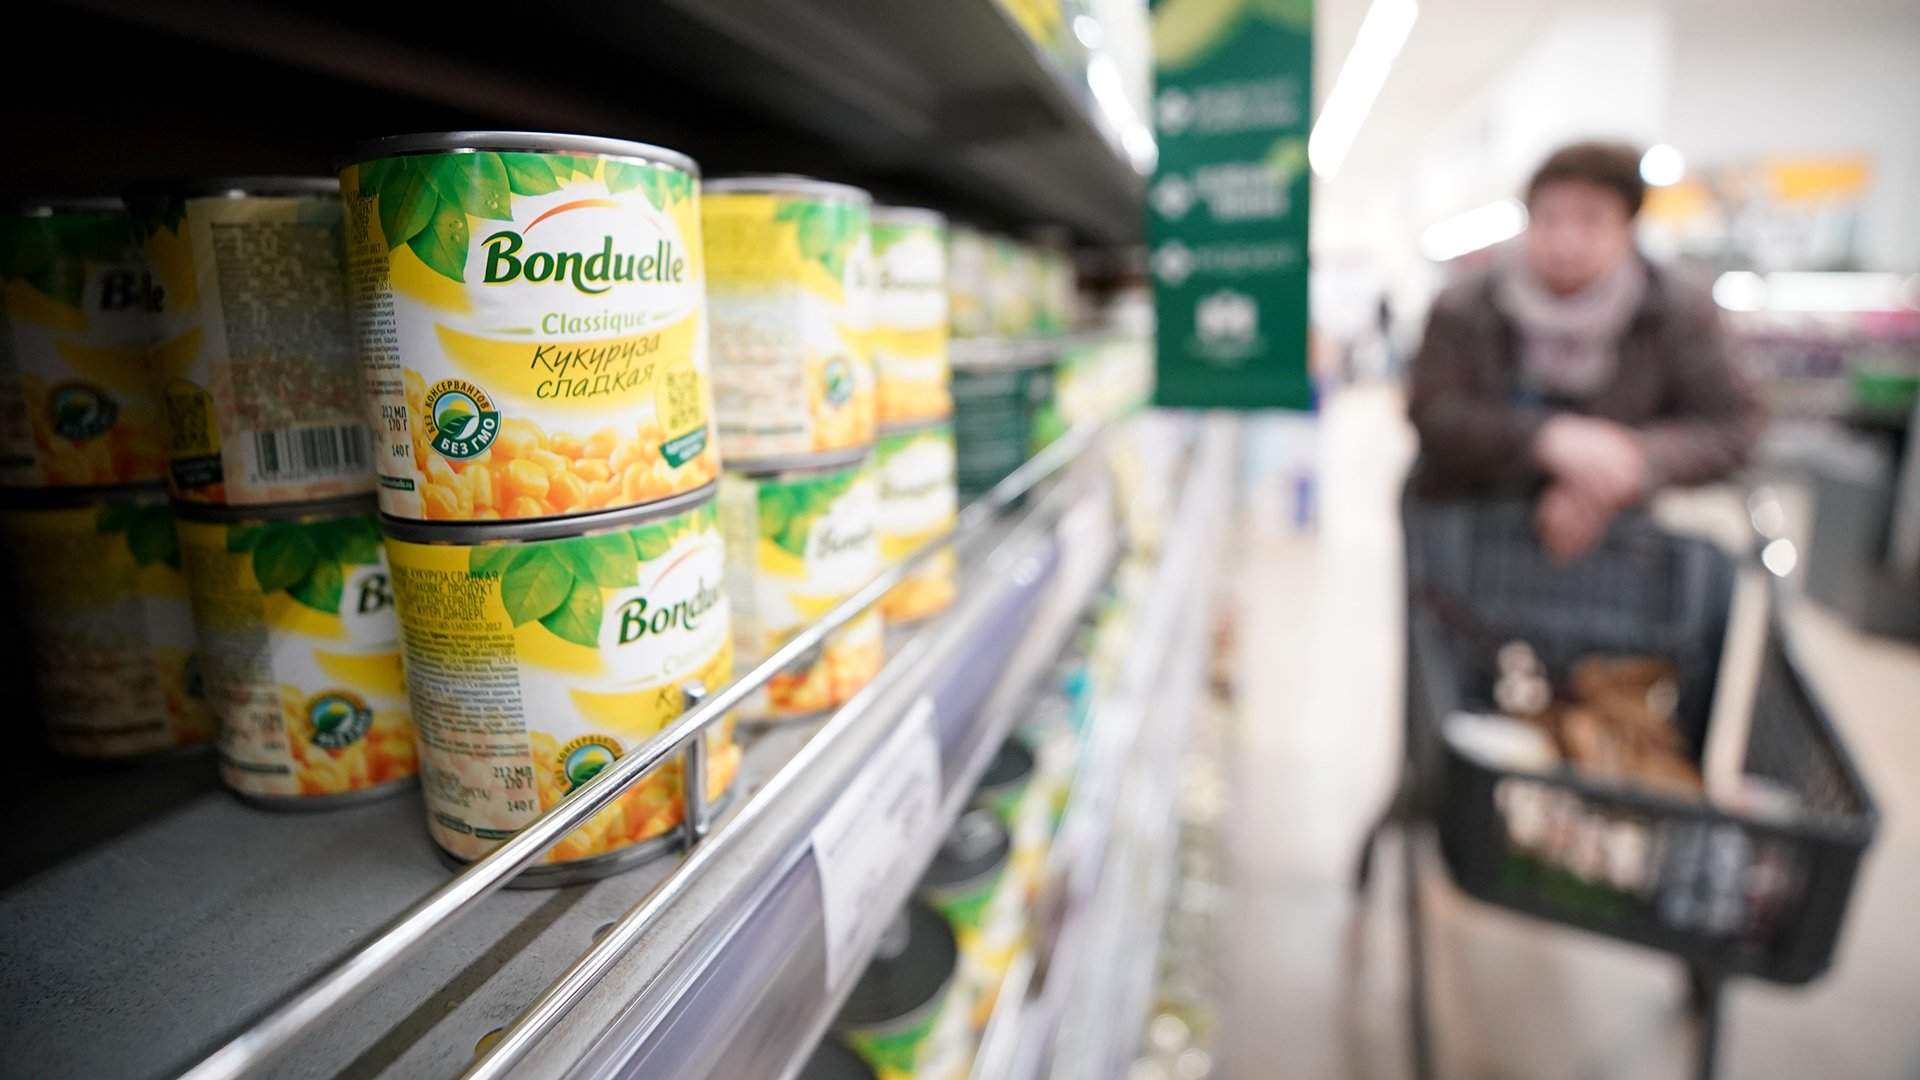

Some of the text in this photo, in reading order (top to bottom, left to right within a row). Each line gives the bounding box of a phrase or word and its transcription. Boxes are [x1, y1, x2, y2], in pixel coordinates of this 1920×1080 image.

[481, 230, 684, 294] Bonduelle
[541, 309, 647, 335] Classique
[531, 333, 661, 377] Кукуруза
[425, 380, 490, 409] КОНСЕРВАНТОВ
[536, 363, 655, 398] сладкая
[440, 418, 496, 455] БЕЗ ГМО
[493, 766, 512, 779] 212
